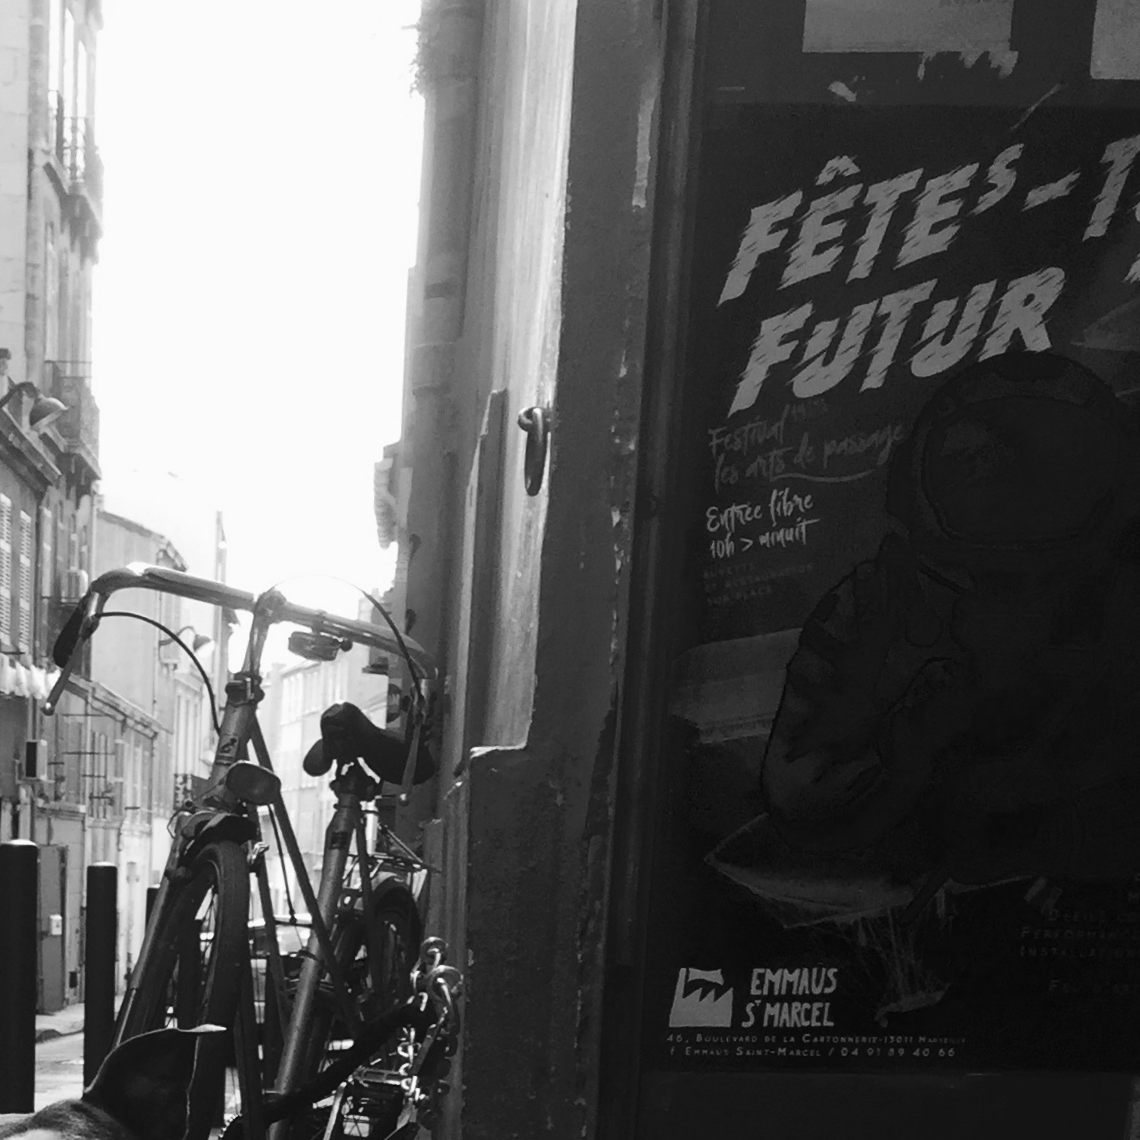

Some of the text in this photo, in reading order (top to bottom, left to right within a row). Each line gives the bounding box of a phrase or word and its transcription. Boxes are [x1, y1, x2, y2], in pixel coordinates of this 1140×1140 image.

[717, 135, 1140, 308] FÊTES-T
[727, 267, 1066, 418] FUTUR
[768, 487, 813, 527] libre
[710, 532, 735, 559] 10h
[758, 517, 821, 548] minuit
[763, 1002, 835, 1028] MARCEL
[696, 1033, 758, 1043] BOULEVARD
[736, 1046, 821, 1056] SAINT-MARCEL
[841, 1047, 859, 1056] 04
[912, 1047, 930, 1056] 40
[938, 1047, 955, 1056] 66
